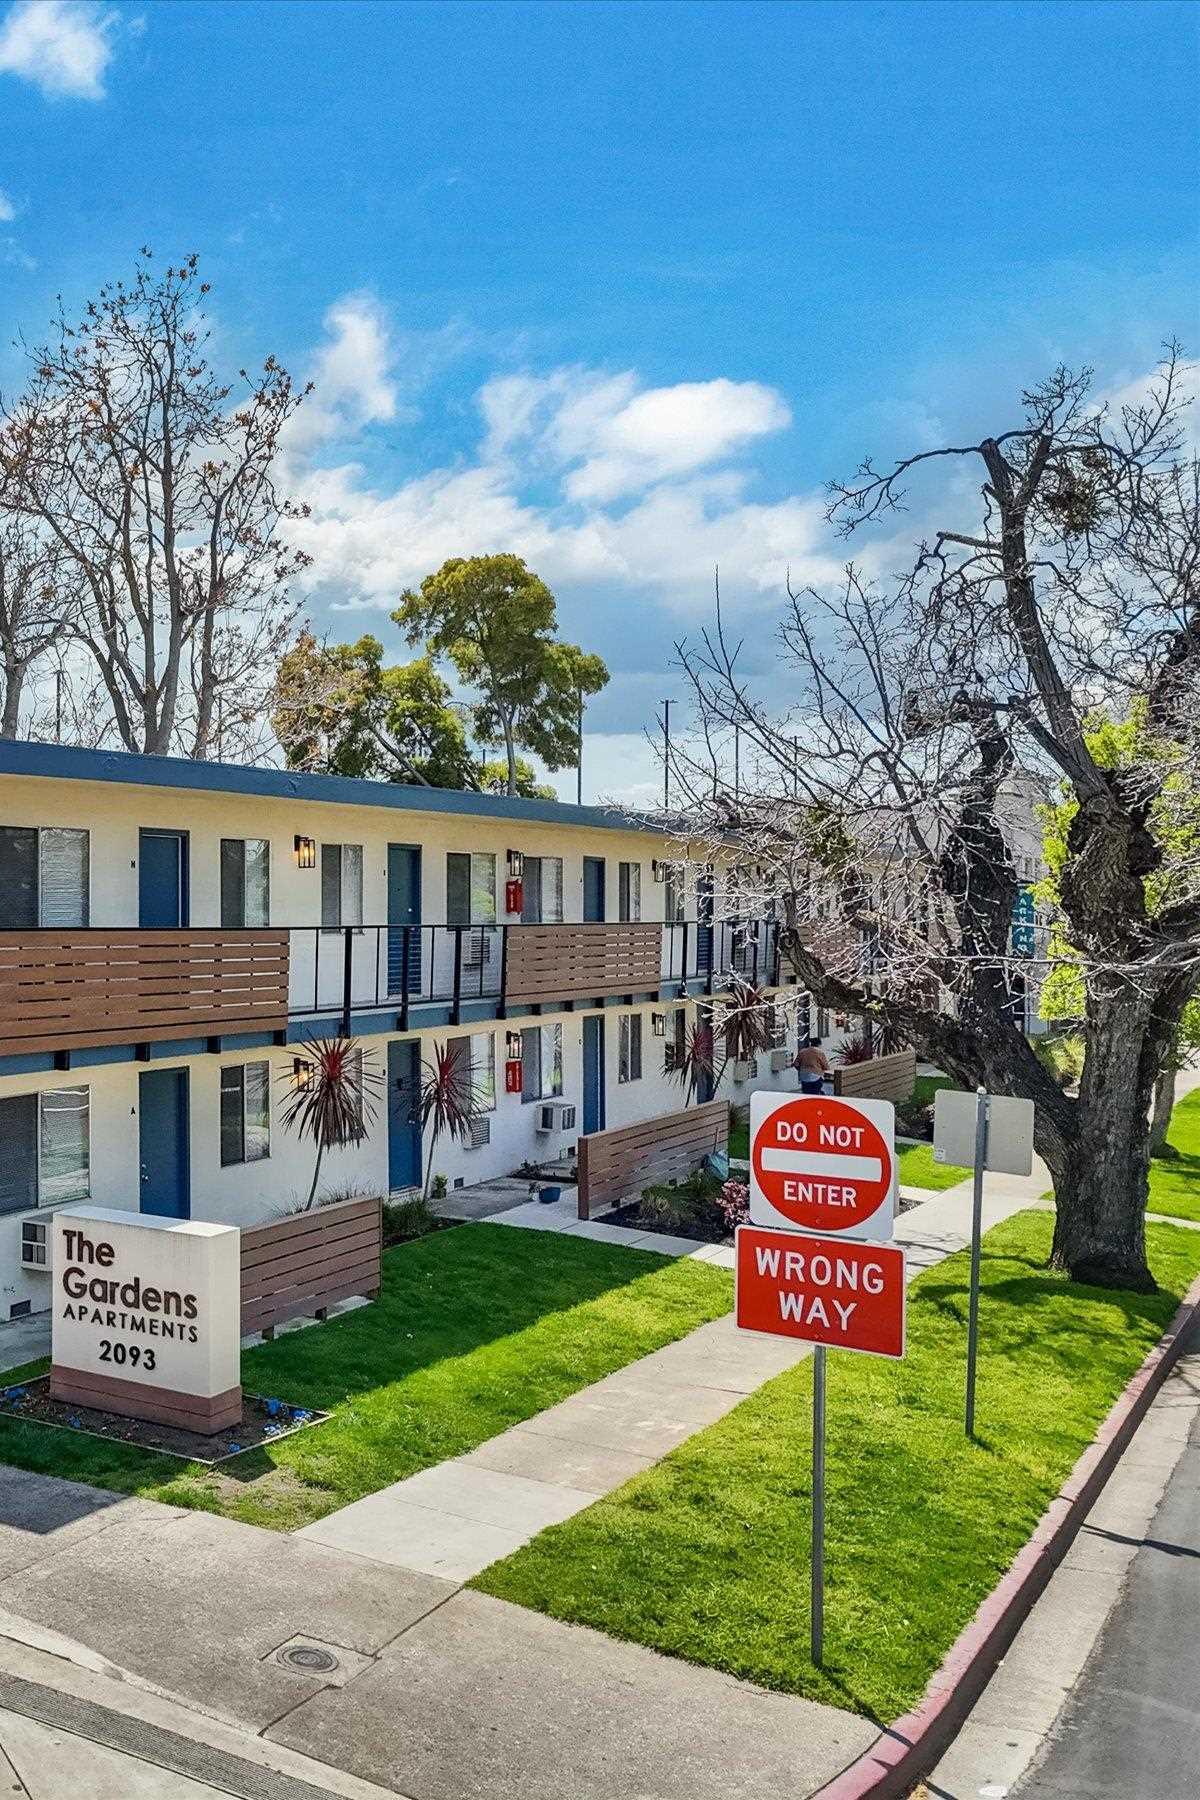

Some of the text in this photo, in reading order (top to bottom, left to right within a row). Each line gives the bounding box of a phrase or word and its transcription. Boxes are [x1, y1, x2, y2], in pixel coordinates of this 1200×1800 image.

[776, 1120, 865, 1149] DO NOT
[783, 1180, 857, 1208] ENTER
[62, 1229, 115, 1267] The
[755, 1246, 884, 1294] WRONG
[62, 1266, 198, 1319] Gardens
[779, 1290, 858, 1331] WAY
[62, 1303, 198, 1343] APARTMENTS
[99, 1339, 157, 1371] 2093
